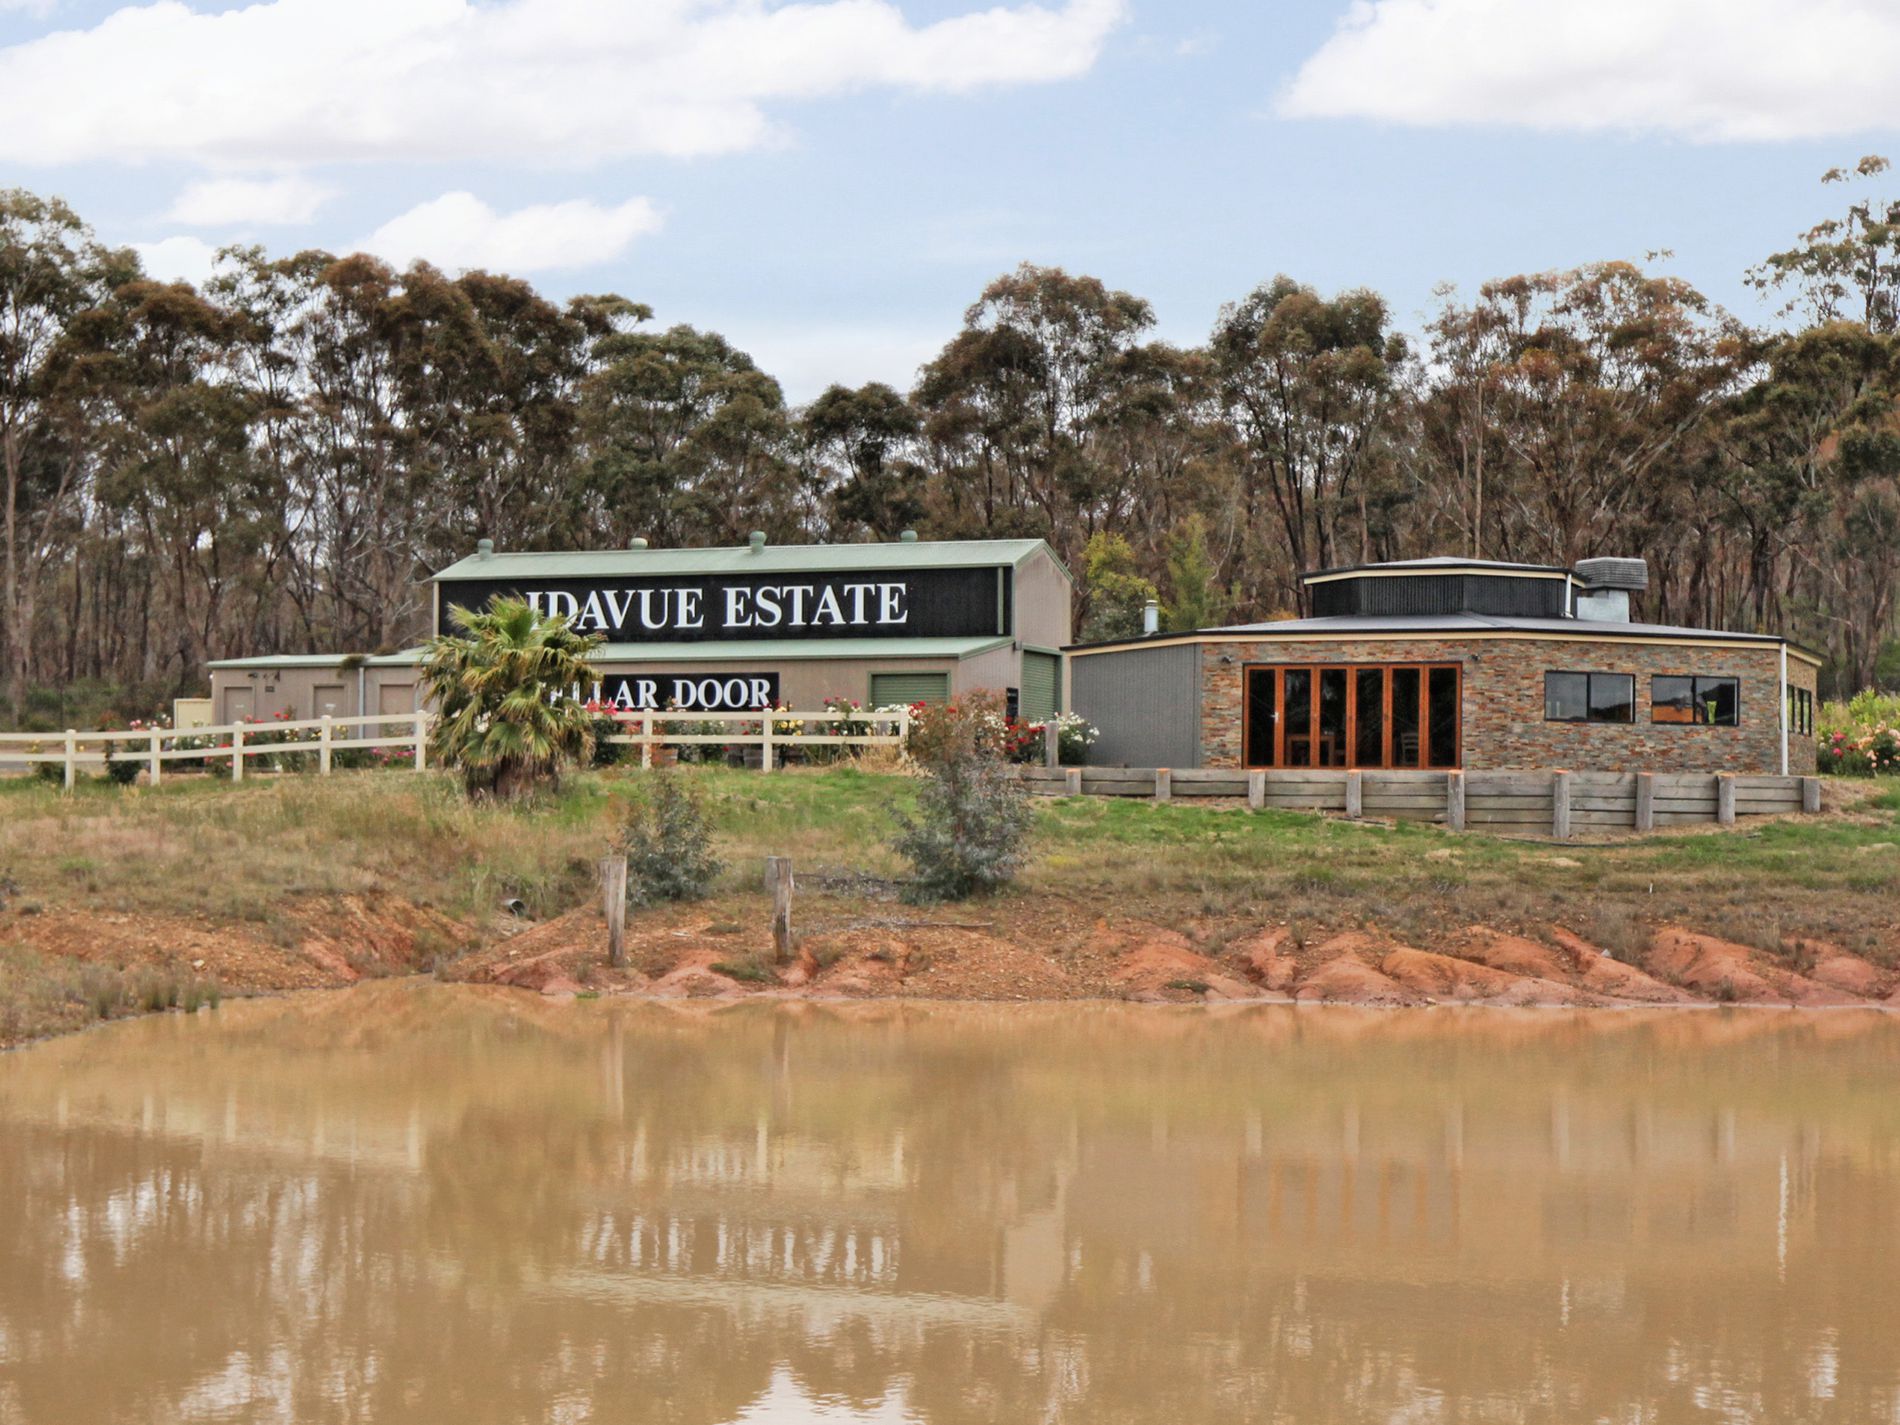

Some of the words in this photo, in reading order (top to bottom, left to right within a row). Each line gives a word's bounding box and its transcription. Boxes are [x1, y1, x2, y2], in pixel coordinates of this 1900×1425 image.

[525, 588, 704, 630] IDAVUE
[722, 583, 908, 627] ESTATE
[672, 678, 771, 709] DOOR
